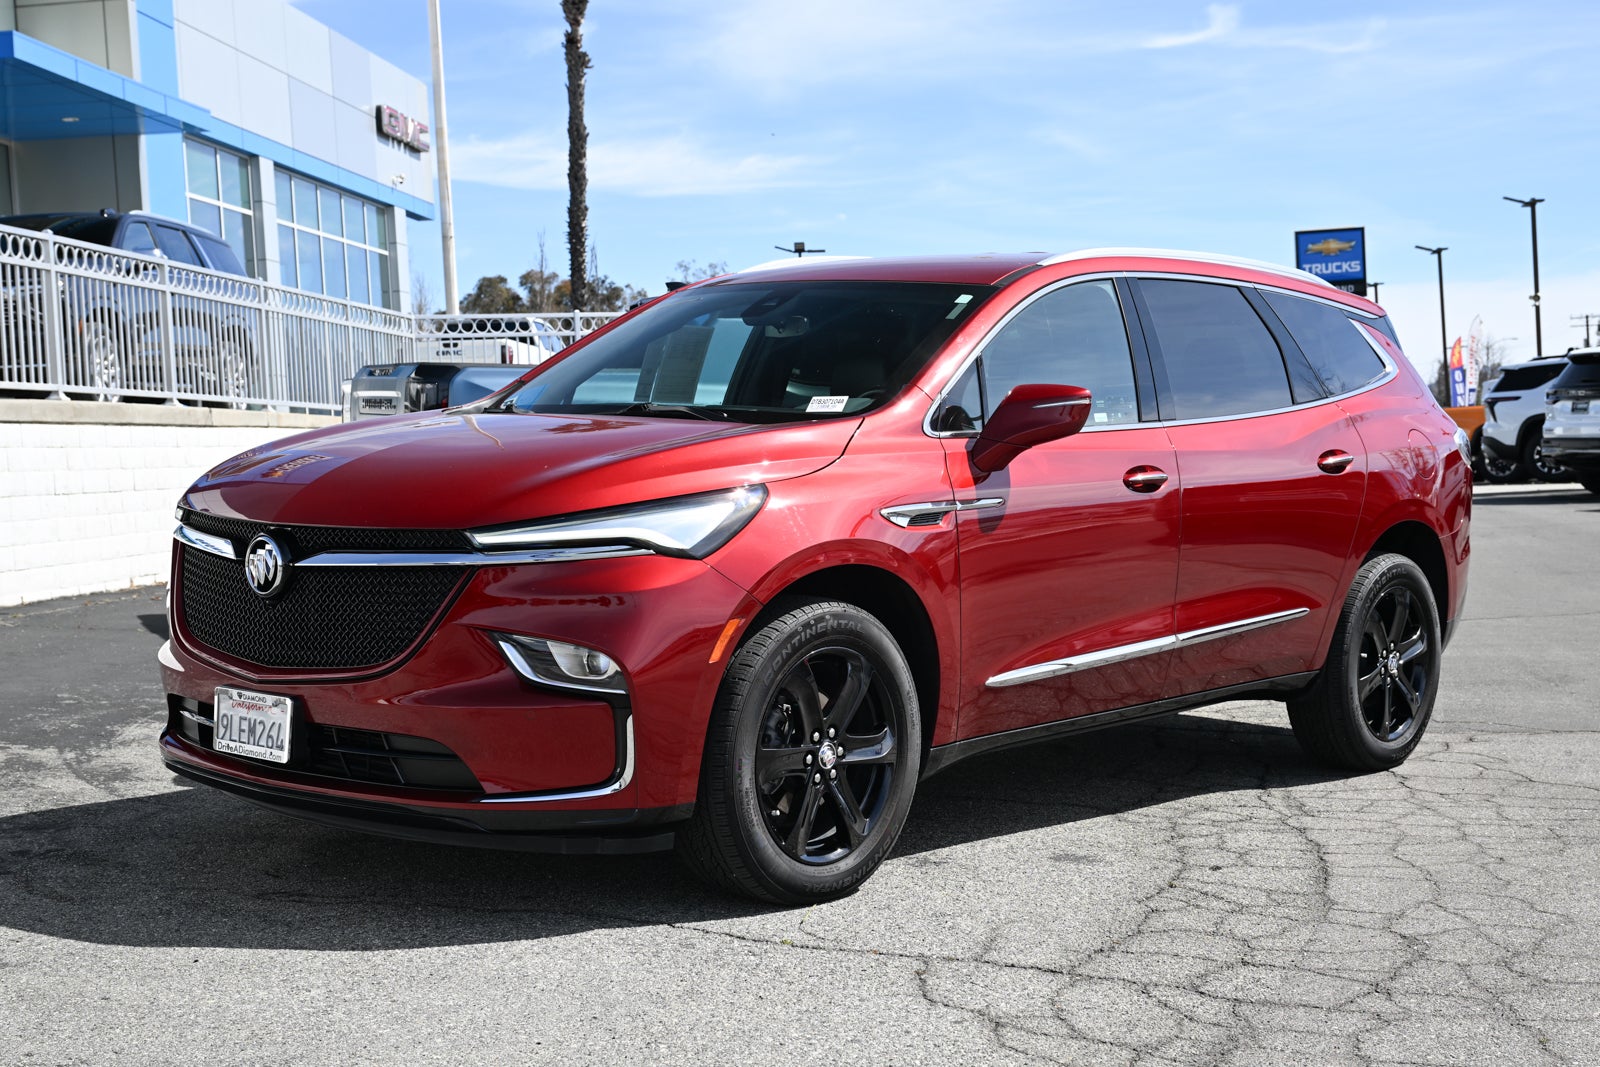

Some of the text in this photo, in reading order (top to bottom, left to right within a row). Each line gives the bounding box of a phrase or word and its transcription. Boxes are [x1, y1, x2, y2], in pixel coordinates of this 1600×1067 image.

[383, 105, 430, 152] GMC
[1302, 260, 1361, 274] TRUCKS
[764, 617, 865, 686] CONTINENTAL
[242, 694, 267, 704] DIAMOND
[219, 712, 284, 752] 9LEM264
[217, 741, 282, 761] DriveADiamond.com
